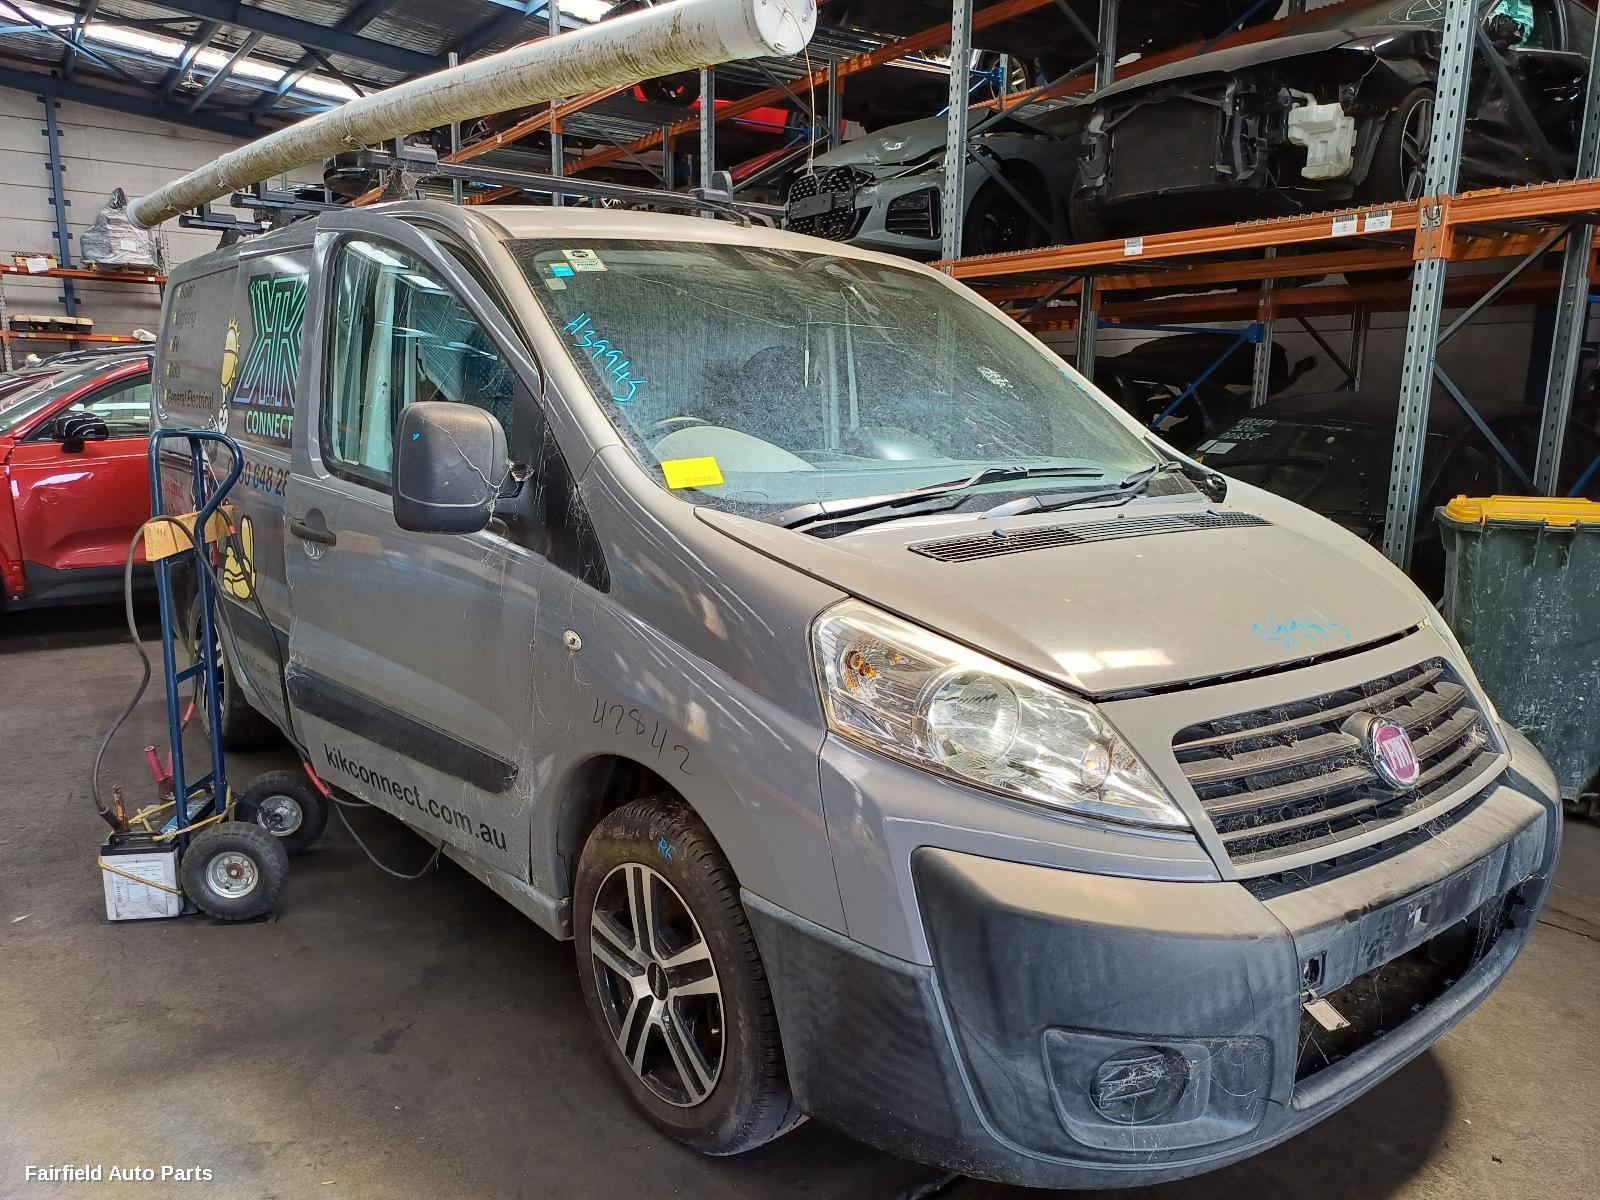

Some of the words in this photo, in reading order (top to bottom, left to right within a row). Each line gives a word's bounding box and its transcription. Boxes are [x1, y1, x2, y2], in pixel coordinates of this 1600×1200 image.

[562, 311, 648, 403] H39945
[167, 388, 187, 407] General
[246, 410, 294, 440] CONNECT
[252, 460, 273, 492] 648
[592, 698, 697, 777] 42842
[323, 742, 508, 852] kikconnect.com.au
